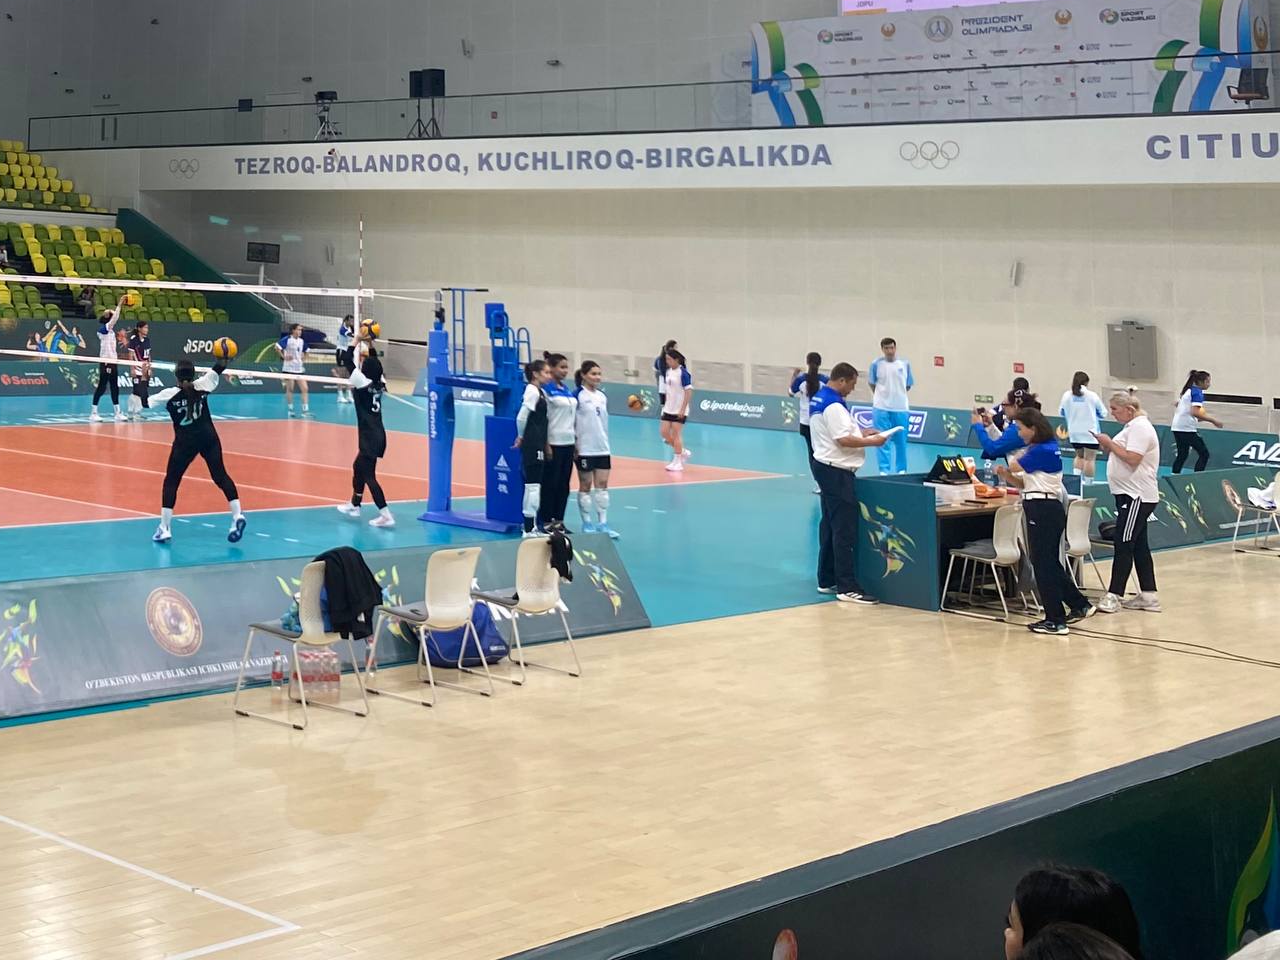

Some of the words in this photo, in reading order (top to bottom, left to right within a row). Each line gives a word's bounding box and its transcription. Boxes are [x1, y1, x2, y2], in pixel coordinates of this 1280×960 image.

[961, 14, 1024, 26] PREZIDENT
[962, 24, 1033, 36] OLIMPIADASI
[1146, 132, 1279, 160] CITIU
[235, 152, 469, 176] TEZROQ-BALANDROQ,
[478, 143, 833, 173] KUCHLIROQ-BIRGALIKDA
[371, 394, 381, 413] 5
